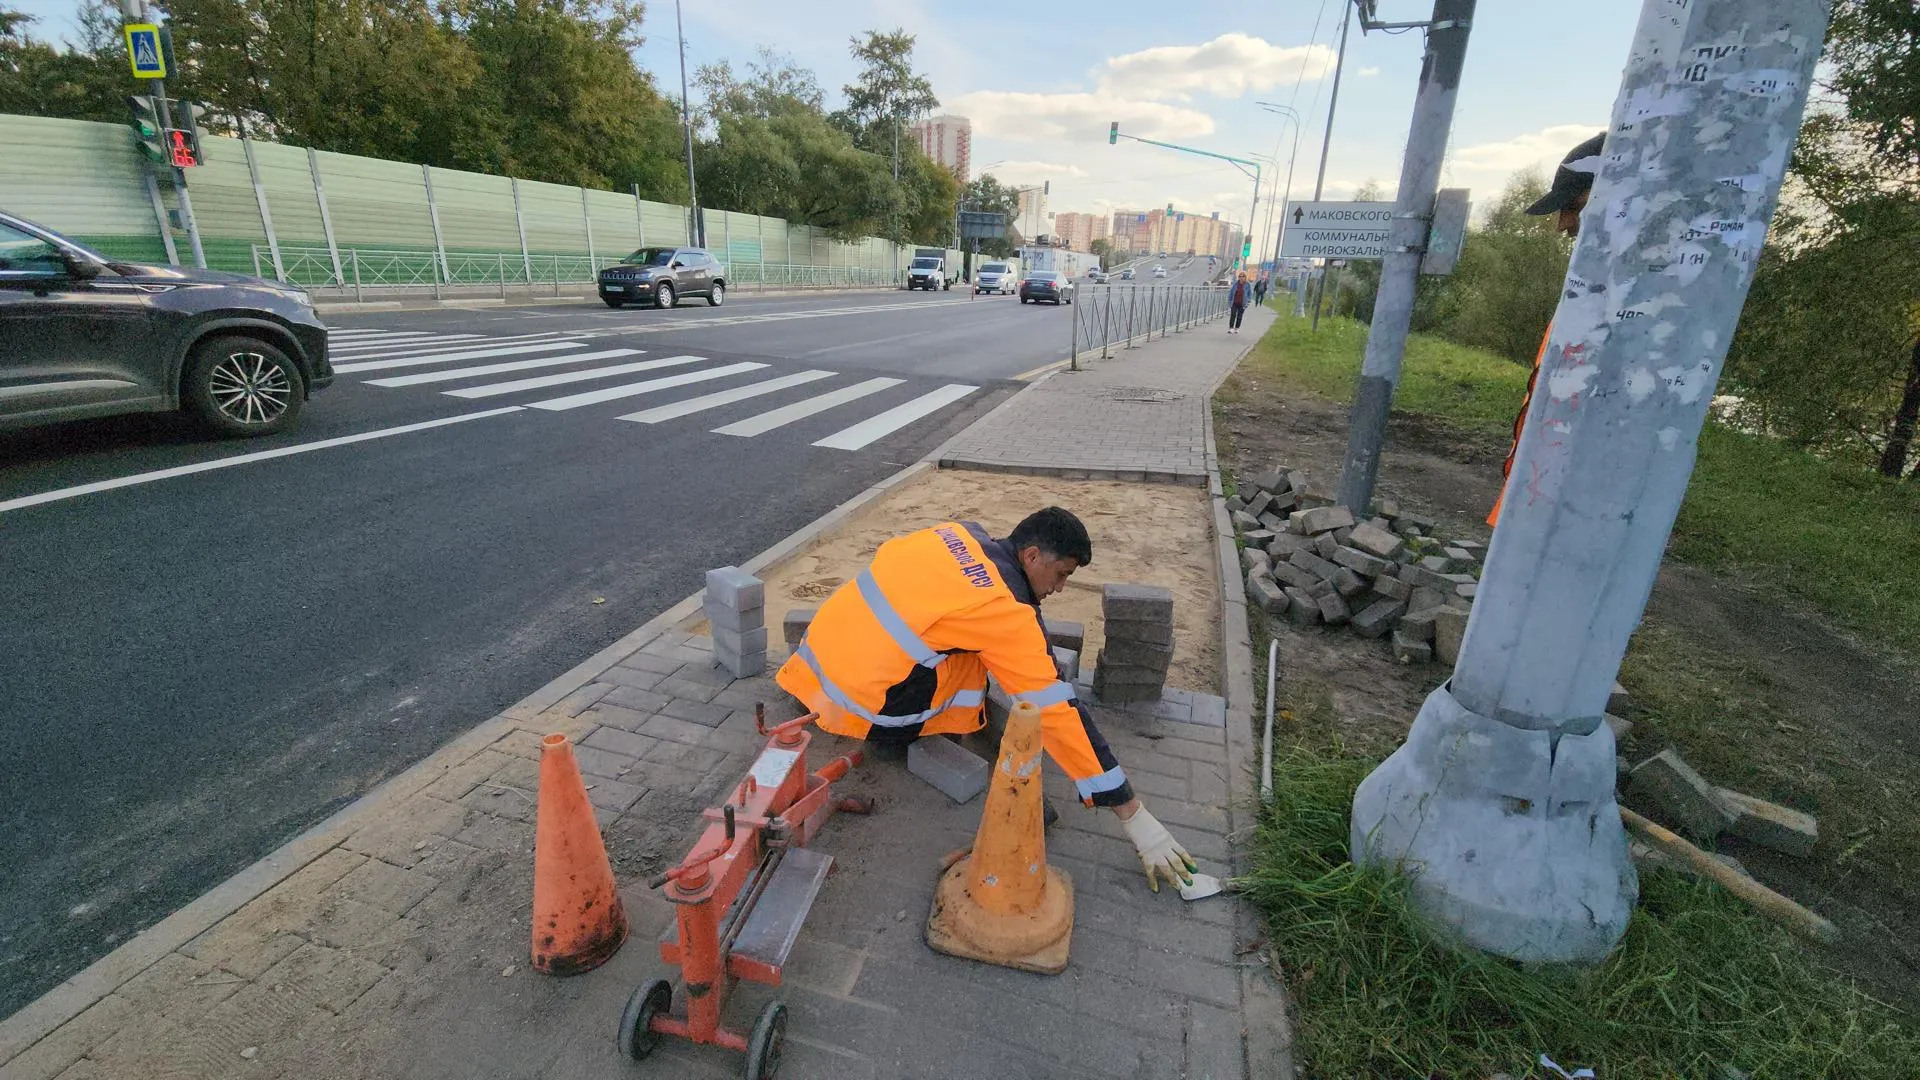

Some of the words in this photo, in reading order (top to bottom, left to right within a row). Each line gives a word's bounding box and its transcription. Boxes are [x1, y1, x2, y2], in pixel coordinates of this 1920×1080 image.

[1308, 210, 1391, 221] МАКОВСКОГО
[1304, 231, 1390, 242] КОММУНАЛЬН
[960, 563, 994, 588] ДРСУ
